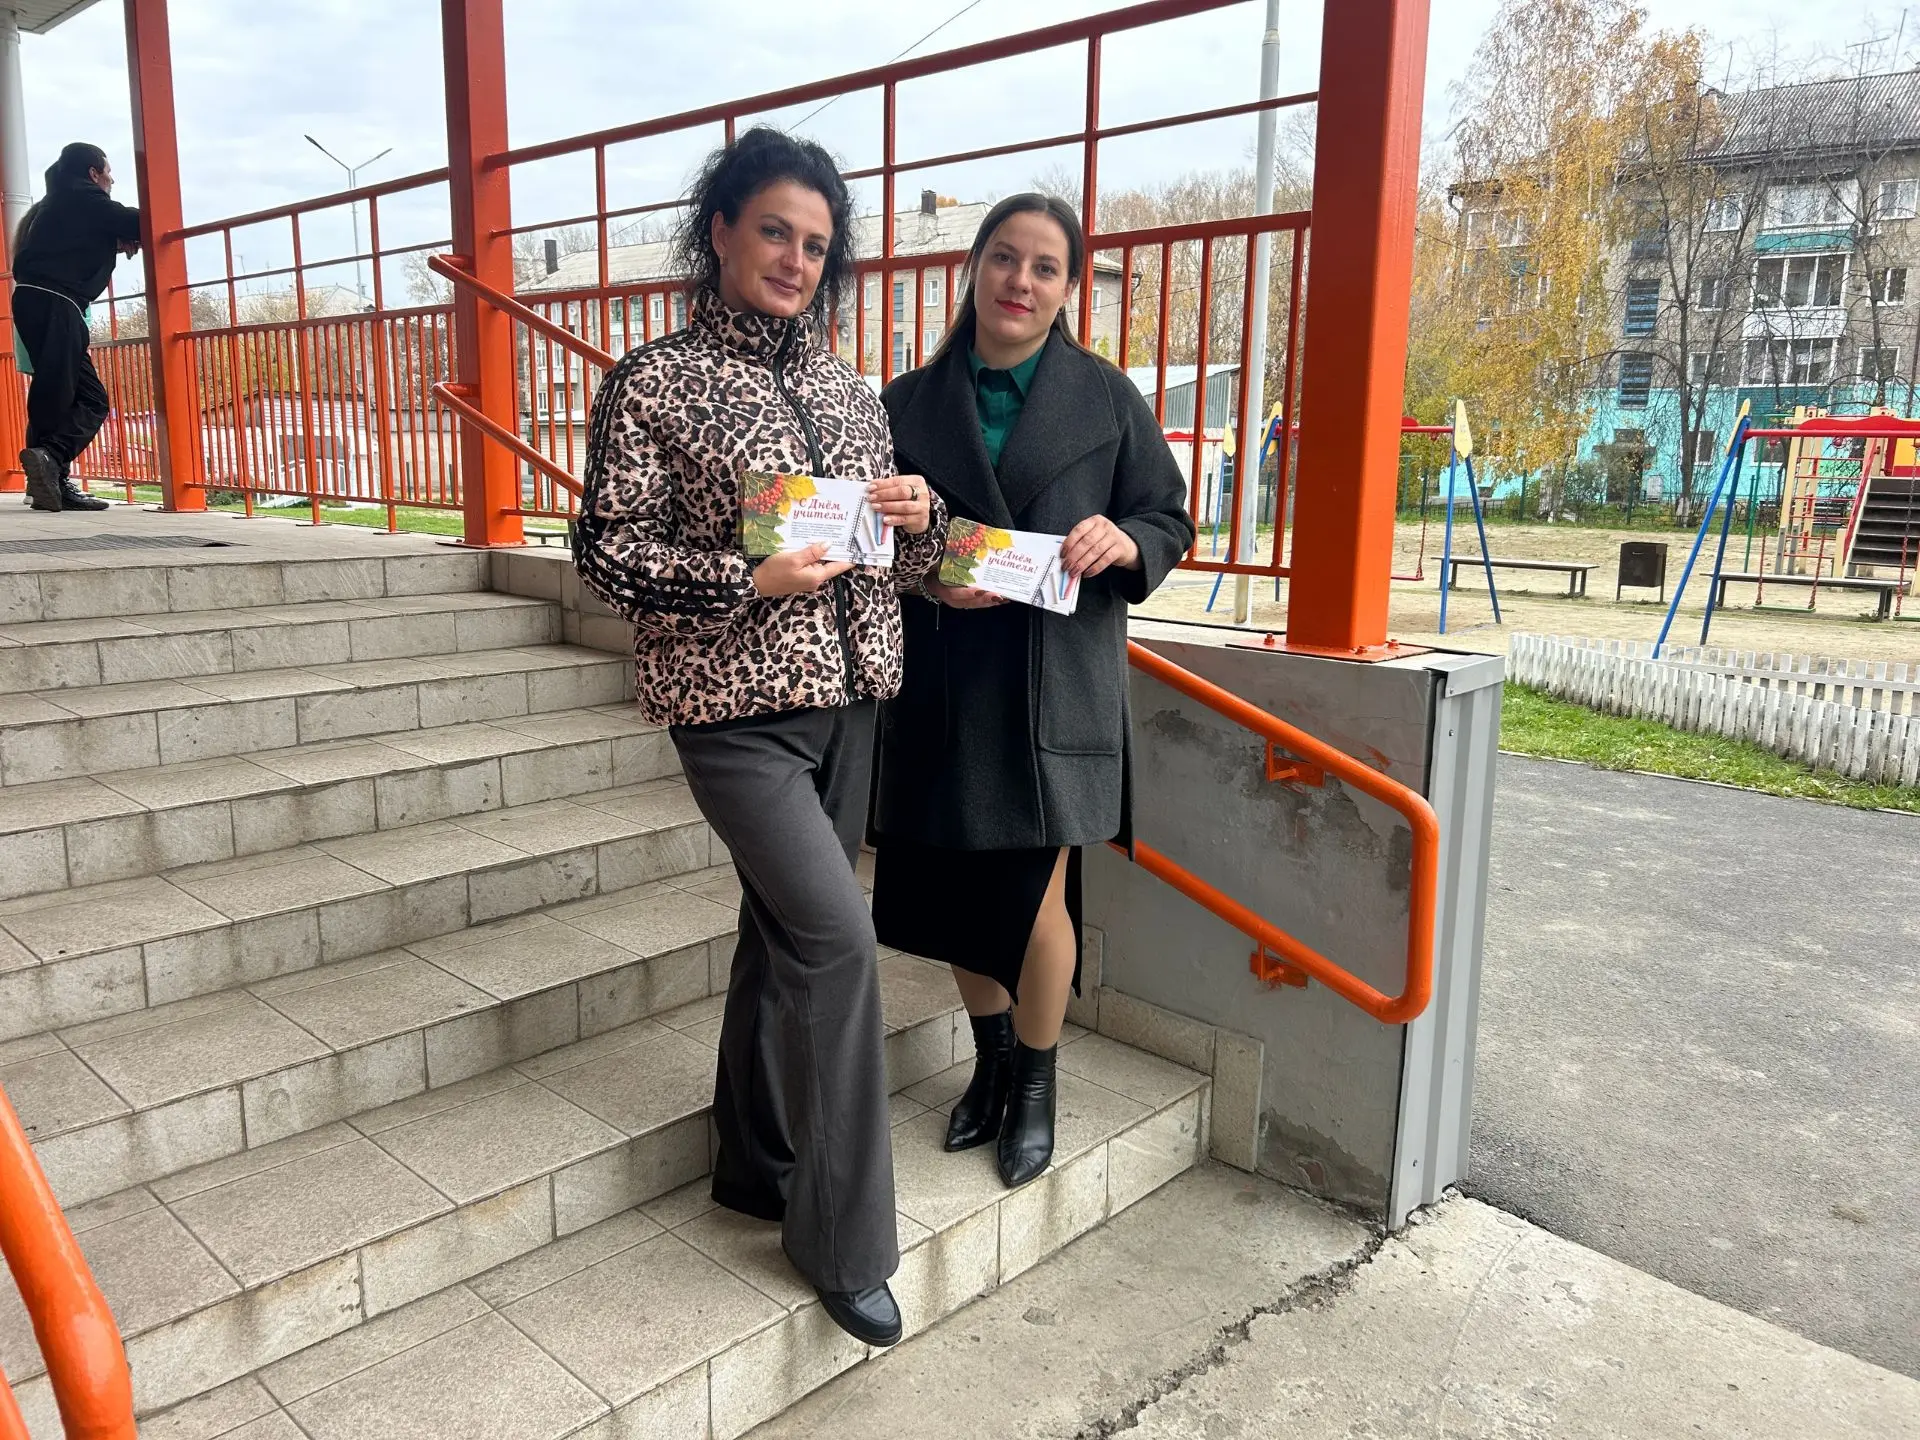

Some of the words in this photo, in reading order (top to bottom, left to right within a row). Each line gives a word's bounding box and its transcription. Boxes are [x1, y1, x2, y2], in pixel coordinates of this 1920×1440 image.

[799, 498, 807, 507] С
[808, 498, 841, 510] Днём
[793, 510, 849, 521] учителя!
[995, 548, 1003, 556] С
[1003, 549, 1032, 563] Днём
[988, 556, 1039, 573] учителя!
